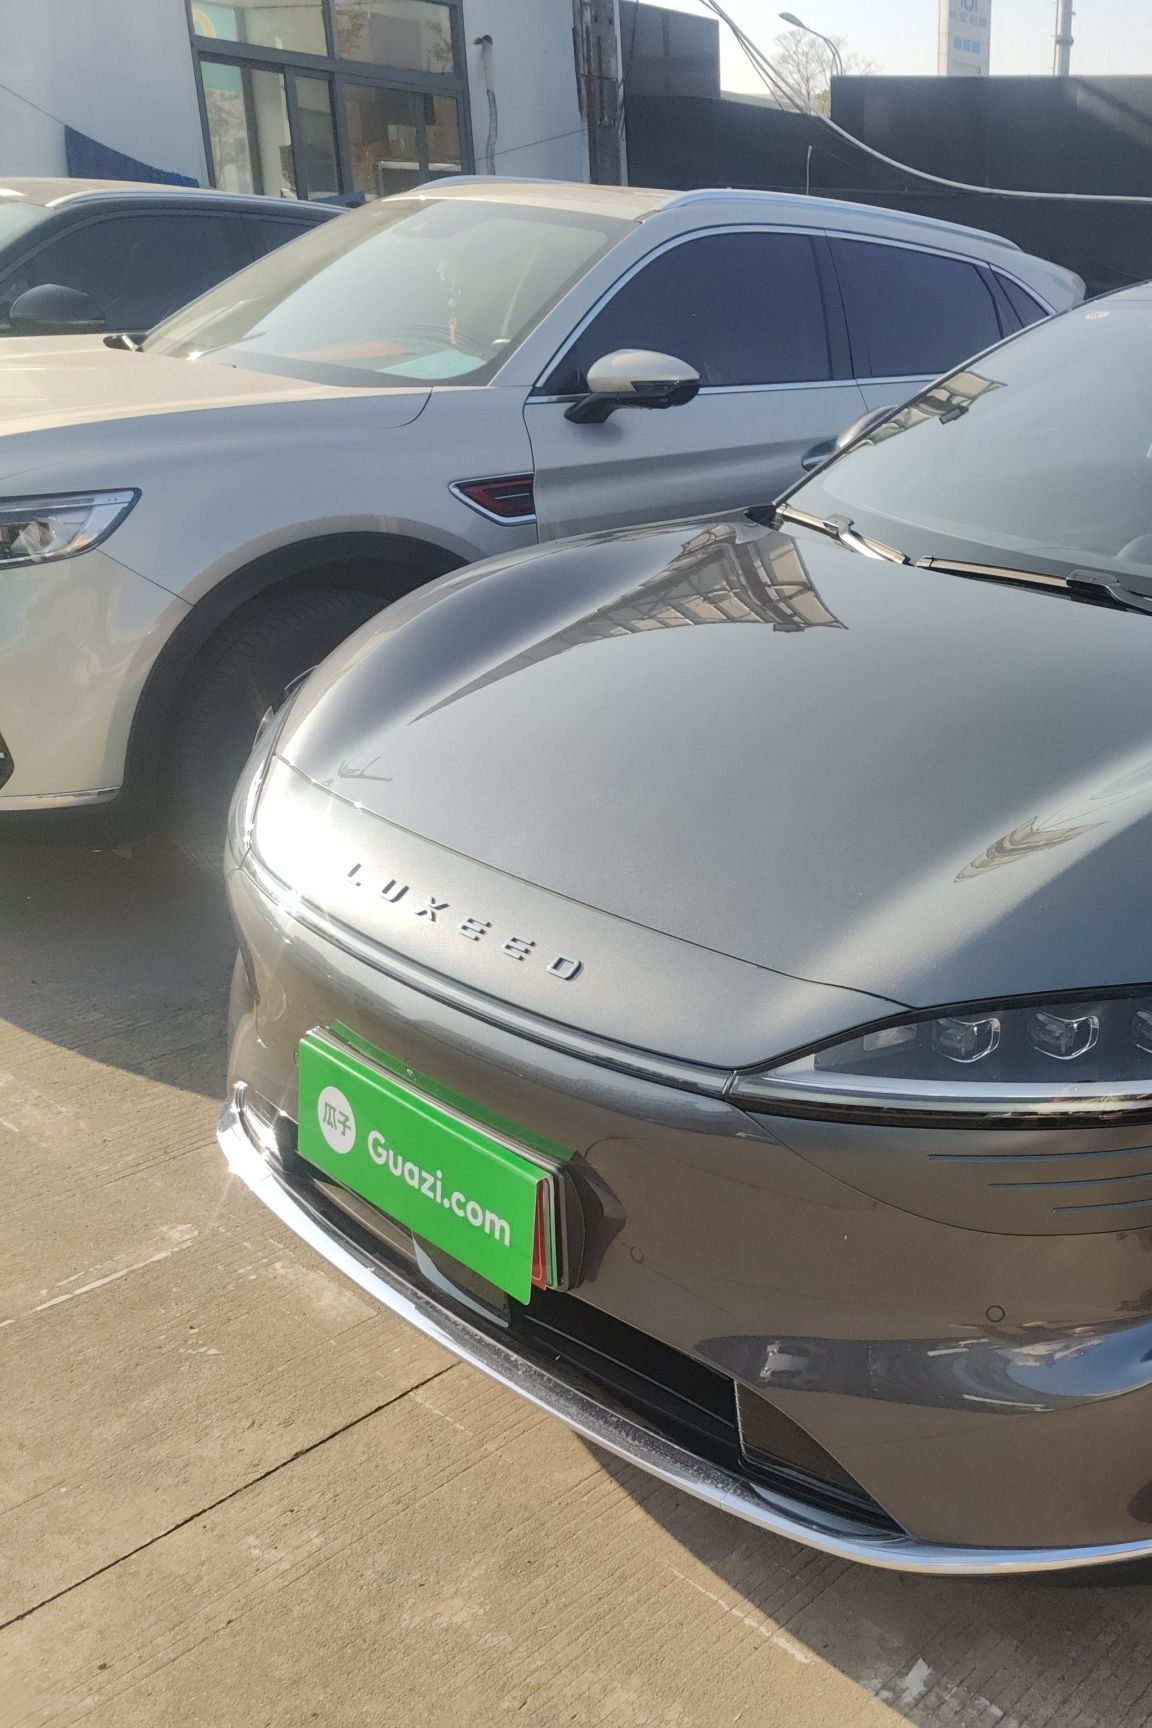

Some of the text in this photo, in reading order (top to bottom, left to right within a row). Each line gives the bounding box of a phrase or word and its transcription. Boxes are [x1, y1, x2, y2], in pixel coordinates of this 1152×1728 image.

[346, 863, 584, 981] LUXEED
[323, 1102, 352, 1137] 瓜子
[367, 1130, 511, 1248] Guazi.com
